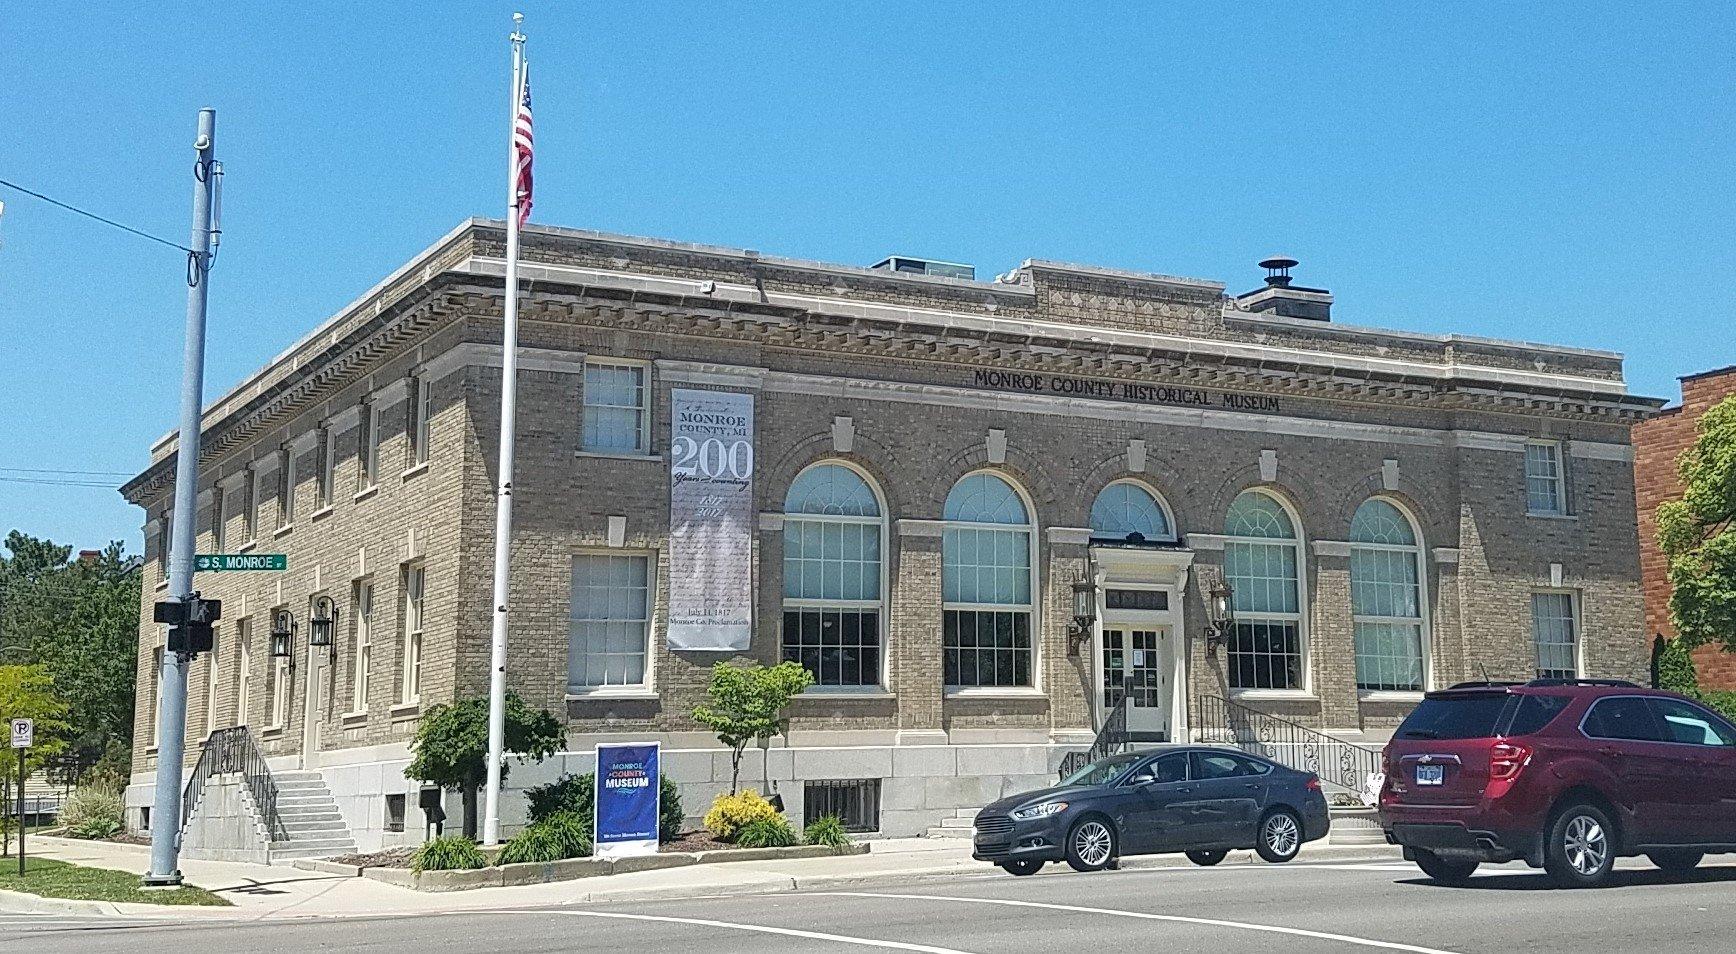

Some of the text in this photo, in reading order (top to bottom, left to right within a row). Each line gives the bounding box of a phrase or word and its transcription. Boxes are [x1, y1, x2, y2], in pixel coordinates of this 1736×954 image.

[974, 370, 1280, 411] MONROE COUNTY HISTORICAL MUSEUM
[680, 413, 746, 426] MONROE
[680, 424, 746, 436] COUNTY, MI
[671, 436, 753, 479] 200
[673, 472, 701, 487] Years
[711, 478, 750, 492] counting
[212, 557, 222, 569] S.
[226, 557, 273, 568] MONROE
[688, 608, 701, 617] July
[714, 608, 731, 616] 1817
[670, 618, 695, 626] Monroe
[708, 618, 749, 627] Proclamation
[605, 778, 649, 788] MUSEUM
